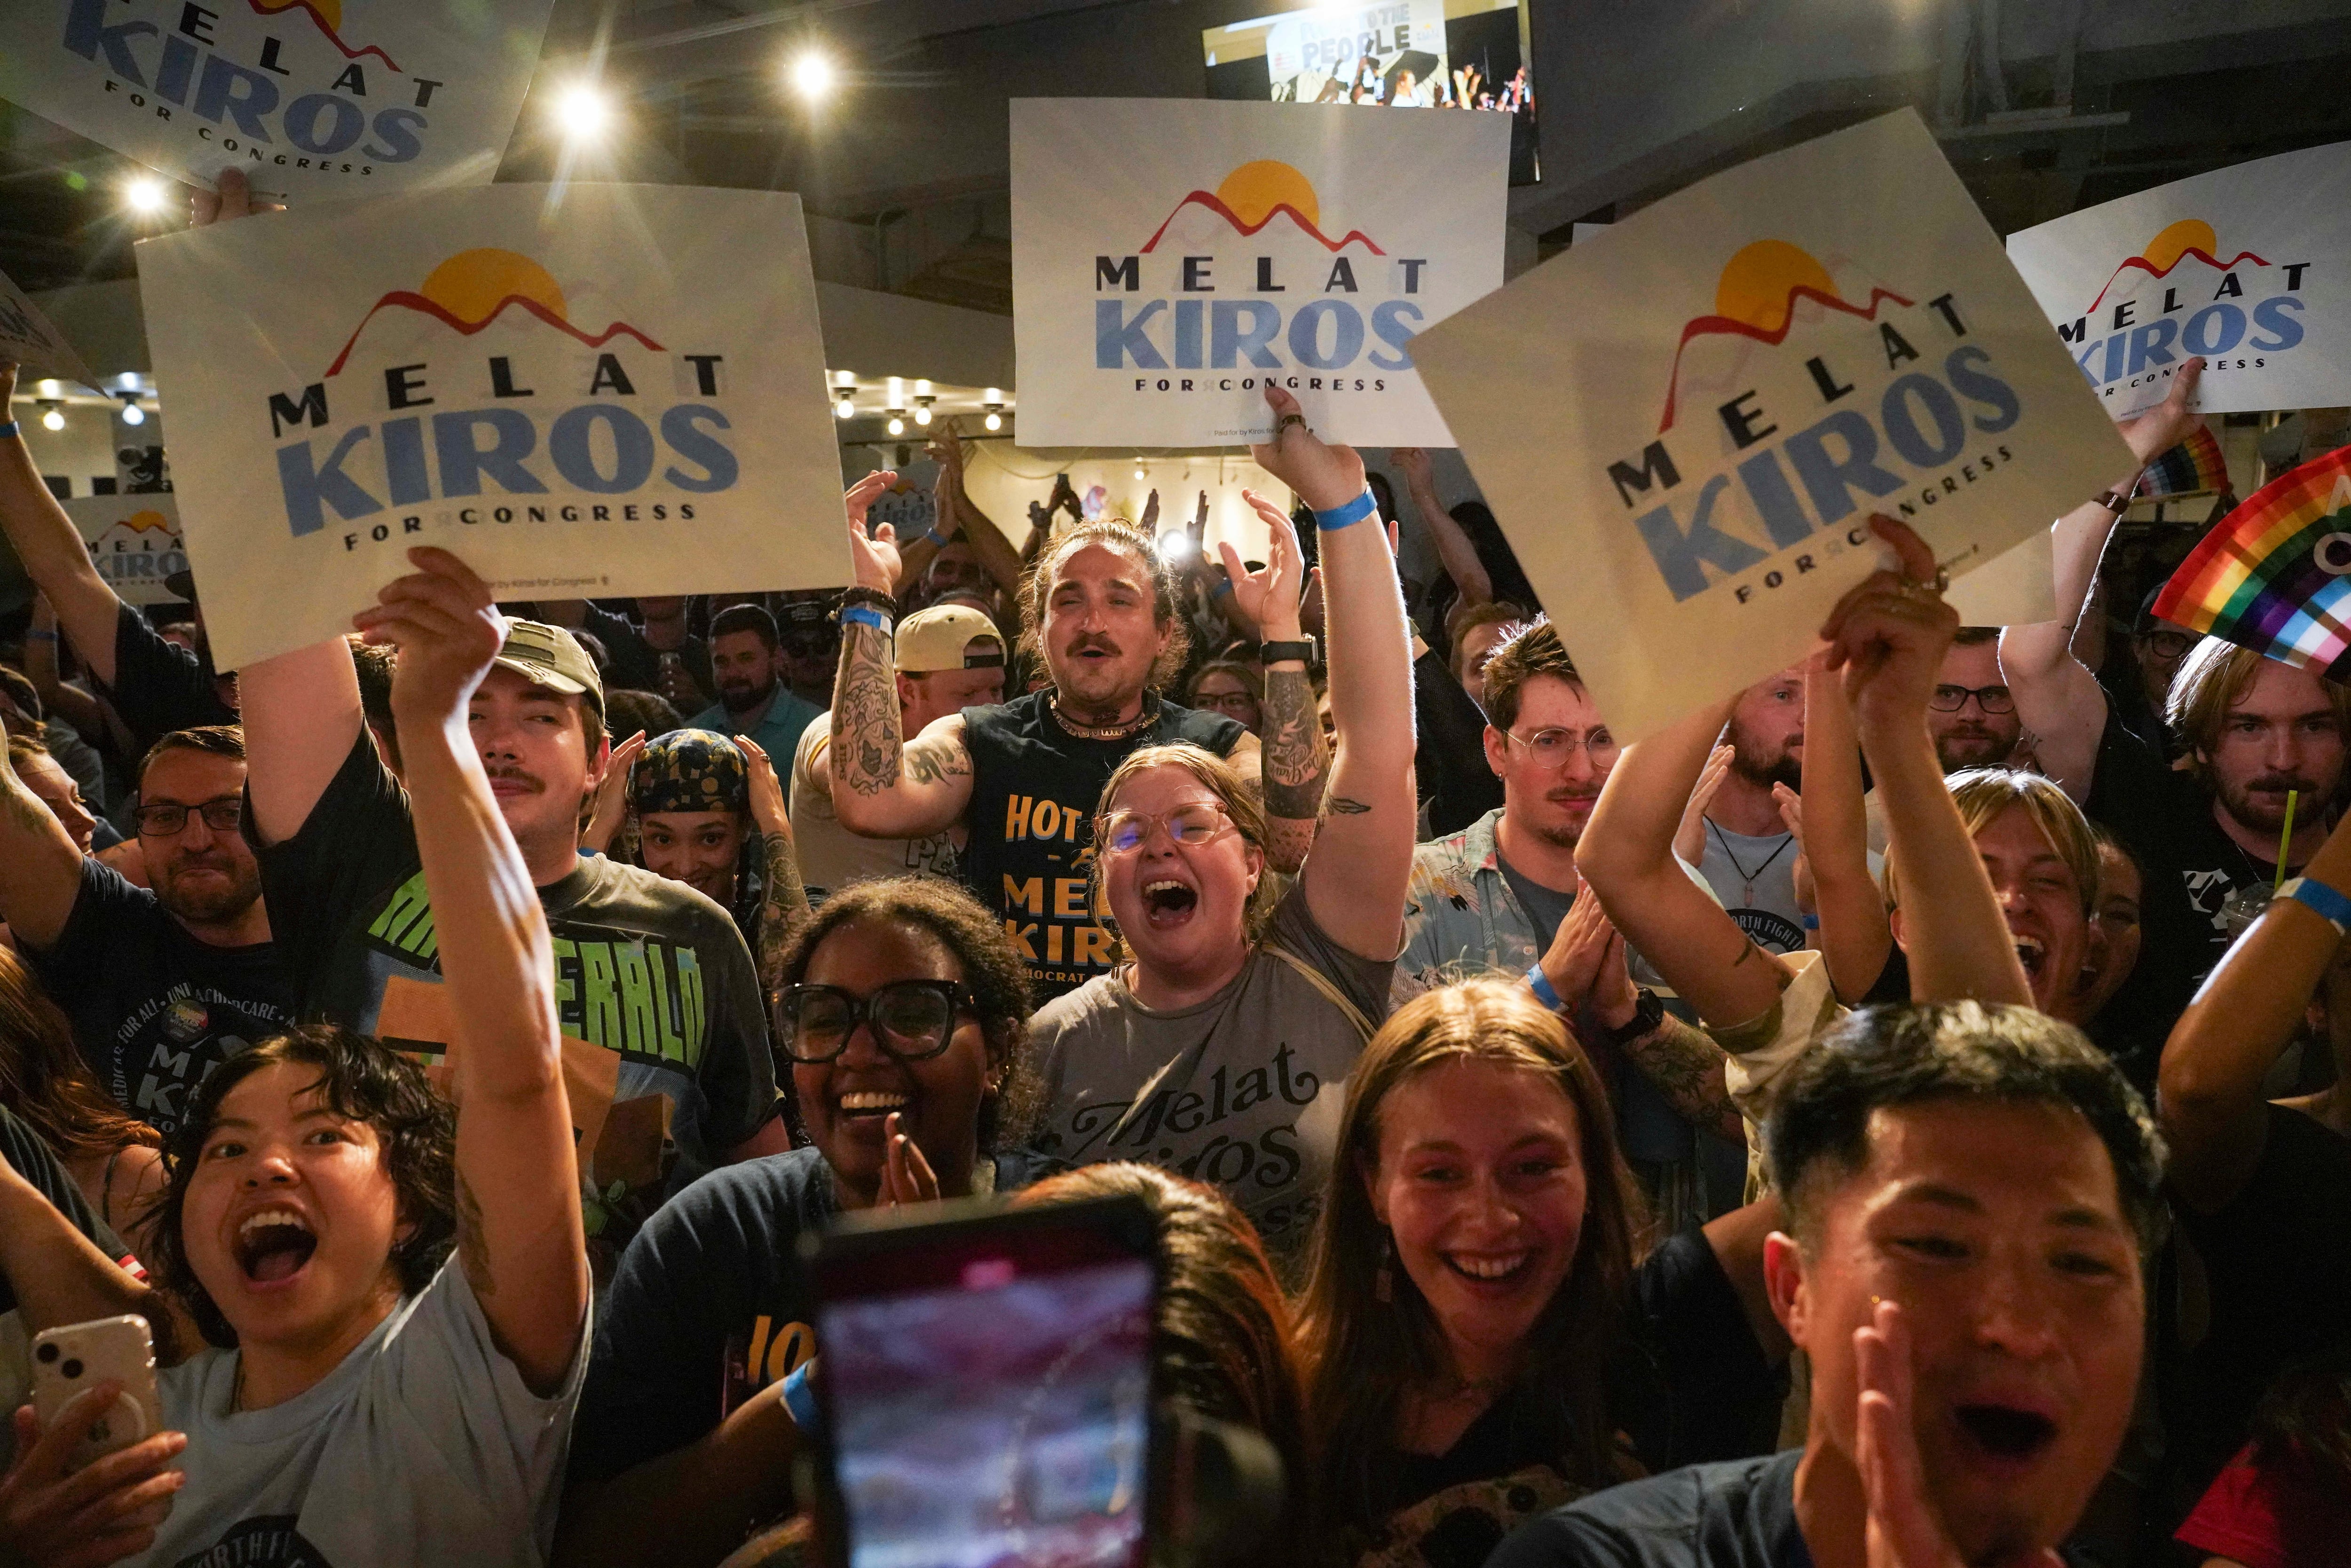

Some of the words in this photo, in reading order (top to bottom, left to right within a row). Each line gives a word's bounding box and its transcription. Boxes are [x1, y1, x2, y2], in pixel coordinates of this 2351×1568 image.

[122, 0, 443, 107] ELAT
[1302, 24, 1411, 69] PEOPLE
[63, 0, 428, 163] KIROS
[105, 80, 171, 121] FOR
[197, 127, 371, 175] CONGRESS
[1096, 256, 1427, 294] MELAT
[2058, 262, 2311, 343] MELAT
[1096, 299, 1424, 370] KIROS
[268, 354, 722, 438] MELAT
[1136, 379, 1194, 391] FOR
[1219, 377, 1385, 392] CONGRESS
[1608, 293, 1968, 508] MELAT
[276, 404, 739, 538] KIROS
[1635, 346, 2020, 603] KIROS
[85, 538, 183, 553] MELA
[345, 516, 421, 551] FOR
[460, 504, 696, 525] CONGRESS
[1735, 555, 1815, 604] FOR
[1847, 444, 2012, 548] CNGRESS
[94, 552, 189, 579] IRO
[1005, 794, 1082, 843] HOT
[1003, 873, 1114, 920] MEL
[1005, 920, 1113, 967] KIR
[1733, 915, 1761, 931] ORTH
[1764, 920, 1806, 951] FIGHTI
[552, 937, 705, 1073] ERALD
[1026, 969, 1086, 983] MOCRAT
[118, 1016, 142, 1045] FOR
[1071, 1041, 1320, 1160] Melat
[1158, 1124, 1302, 1189] ros
